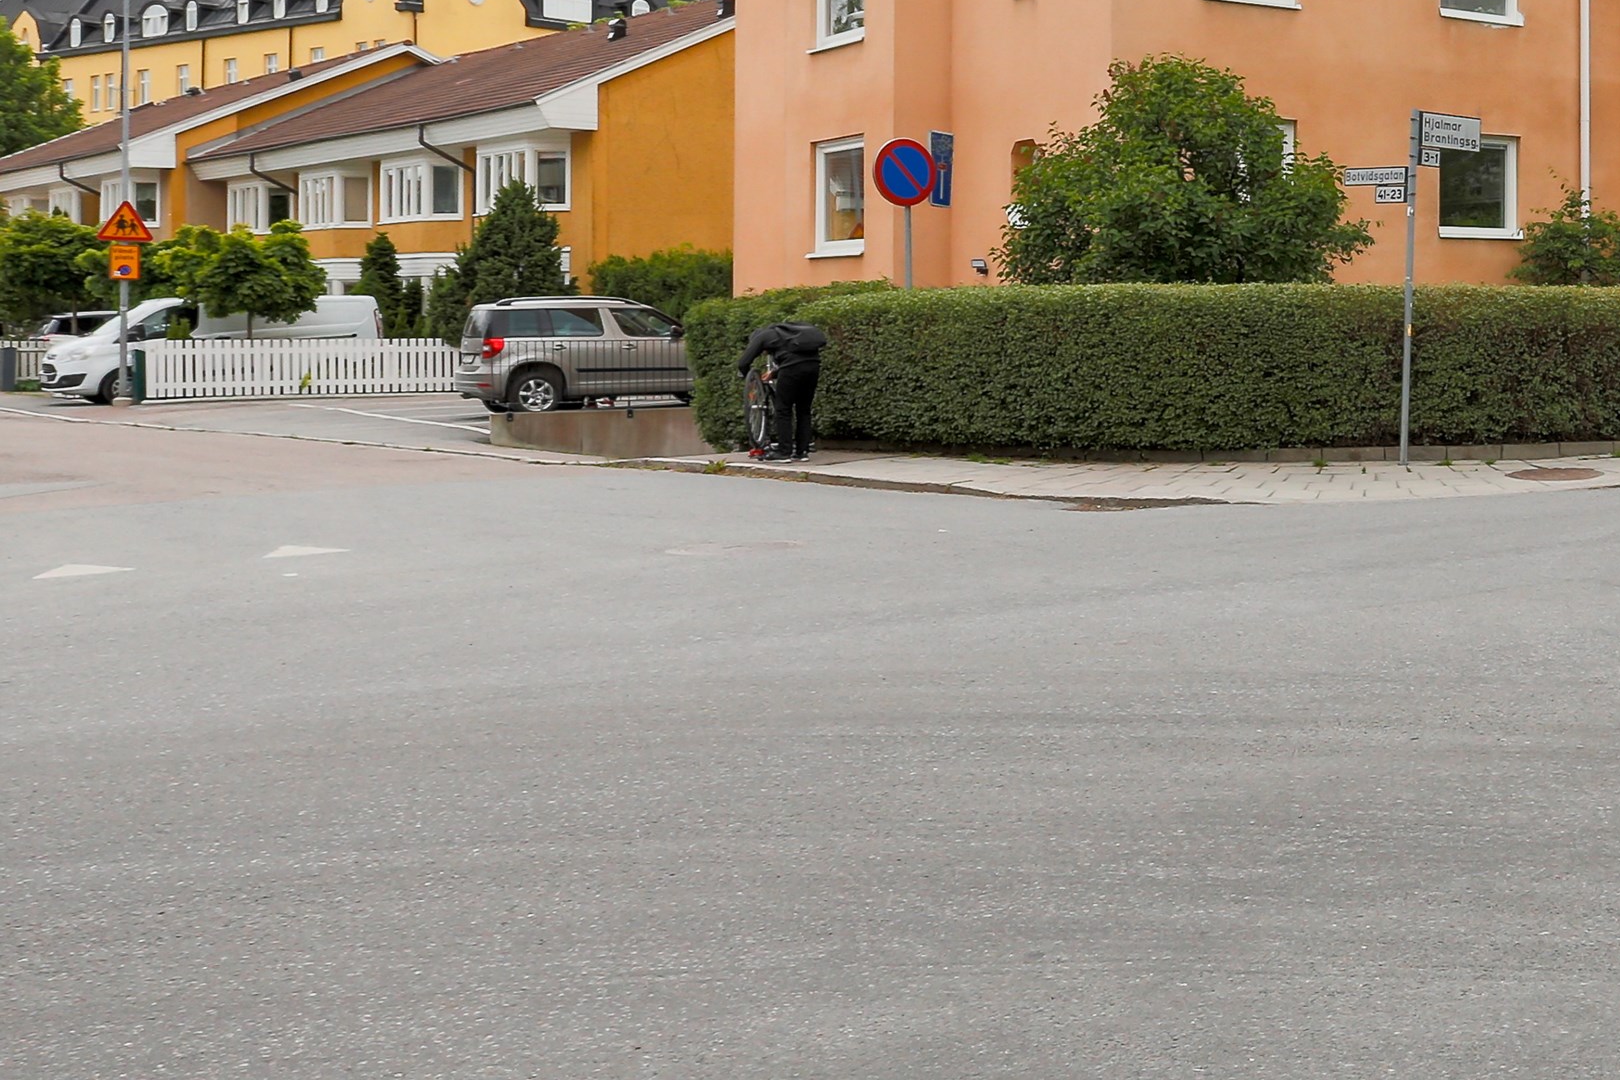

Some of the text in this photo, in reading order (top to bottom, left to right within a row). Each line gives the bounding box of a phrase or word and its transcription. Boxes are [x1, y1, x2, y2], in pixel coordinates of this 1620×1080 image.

[1424, 117, 1462, 131] Hjalmar
[1424, 131, 1479, 149] Brantingsg.
[1424, 152, 1439, 163] 3-1
[1346, 170, 1404, 182] Botvidsgatan
[1377, 189, 1402, 200] 41-23
